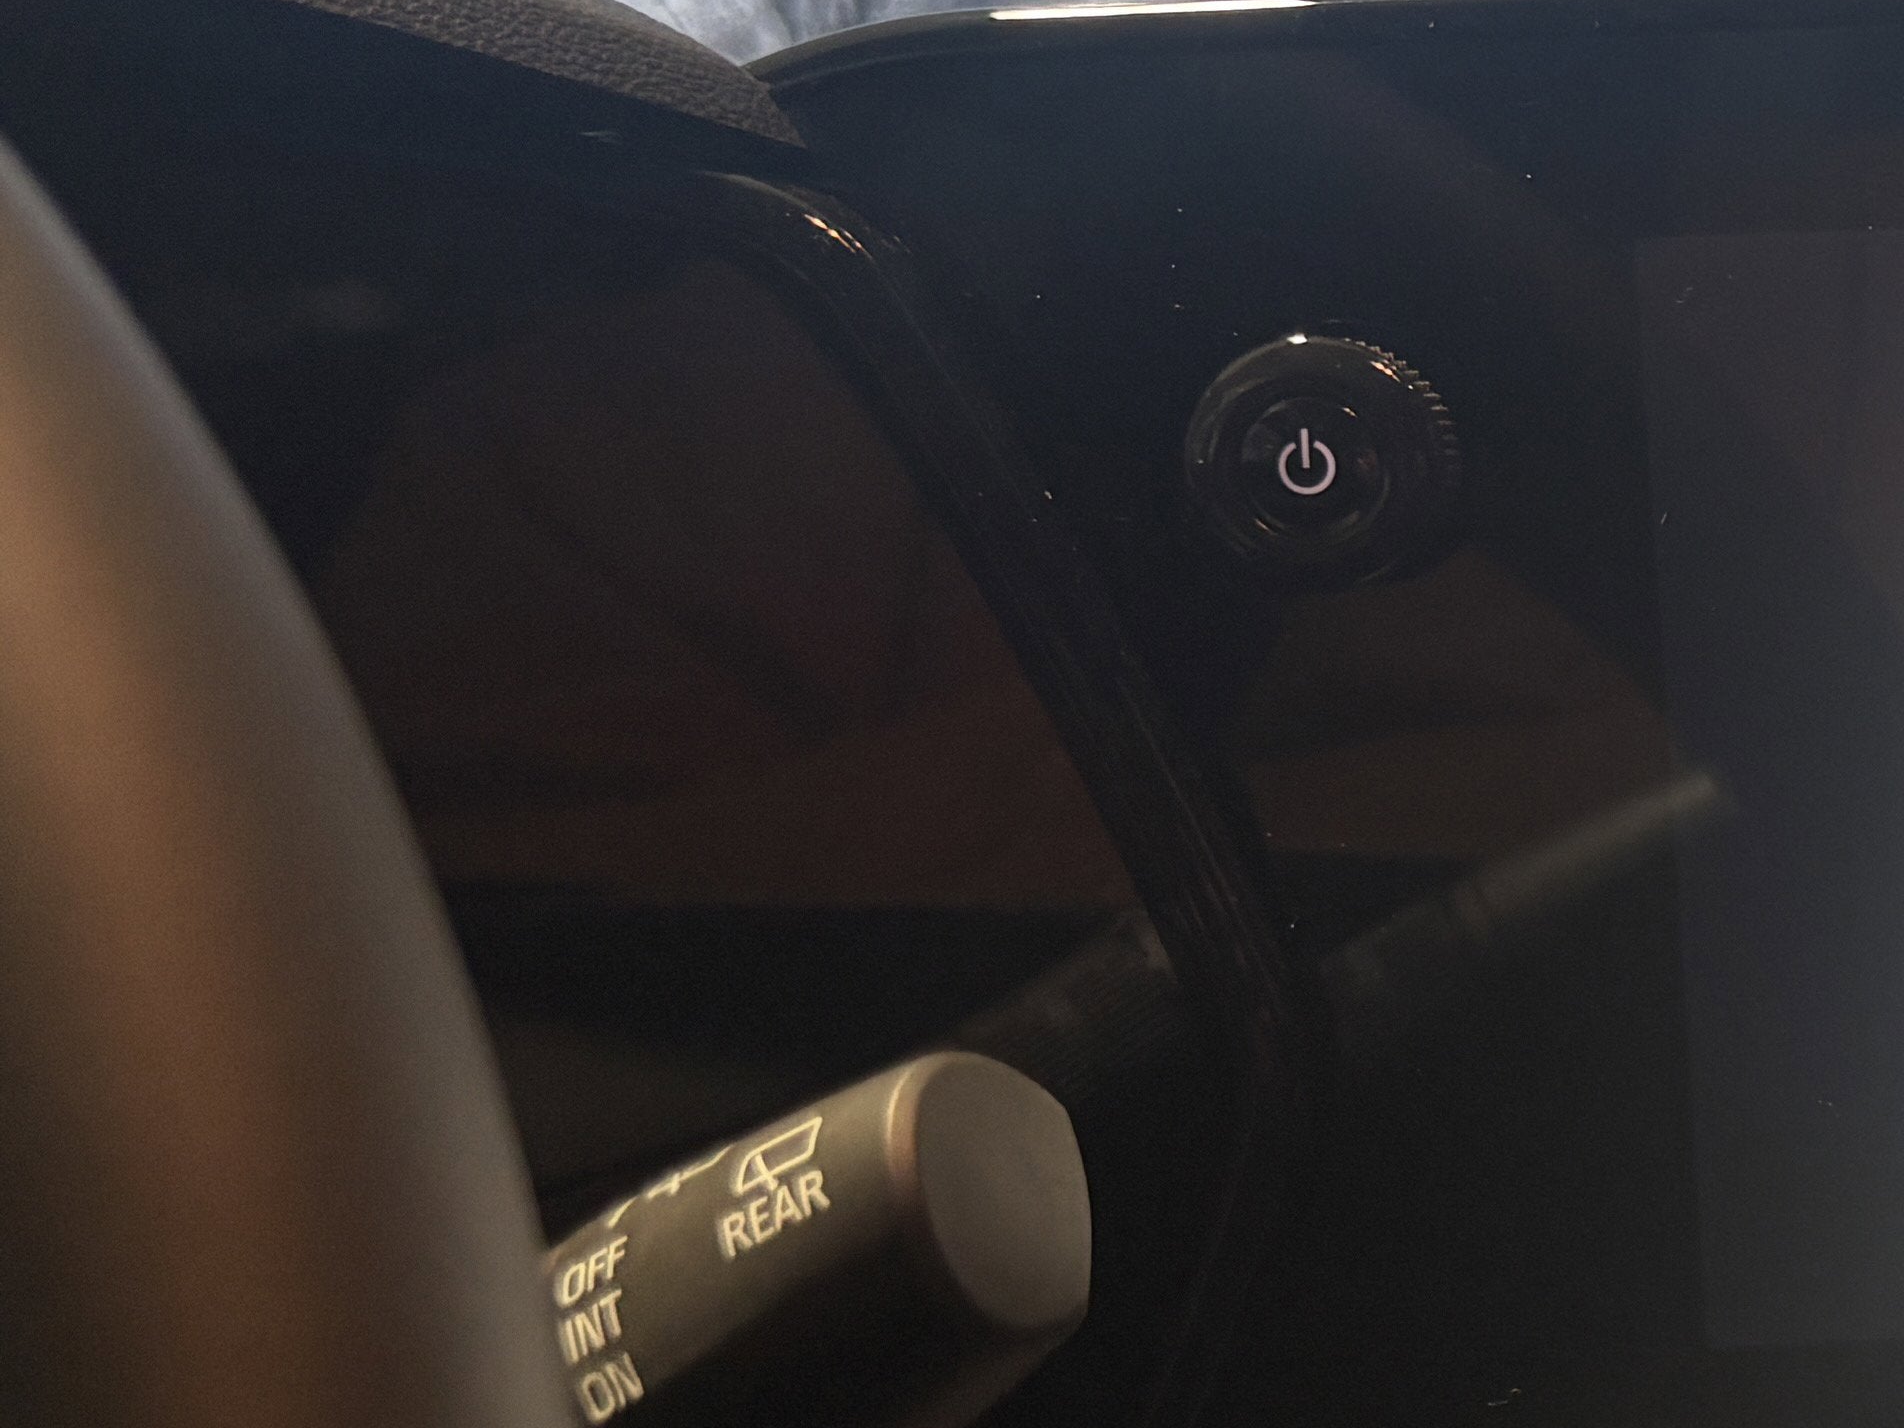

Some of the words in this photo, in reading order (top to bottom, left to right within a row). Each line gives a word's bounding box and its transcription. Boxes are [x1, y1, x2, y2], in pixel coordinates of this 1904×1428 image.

[719, 1169, 830, 1259] REAR
[556, 1236, 628, 1308] OFF
[561, 1288, 622, 1364] INT
[580, 1352, 645, 1424] ON
